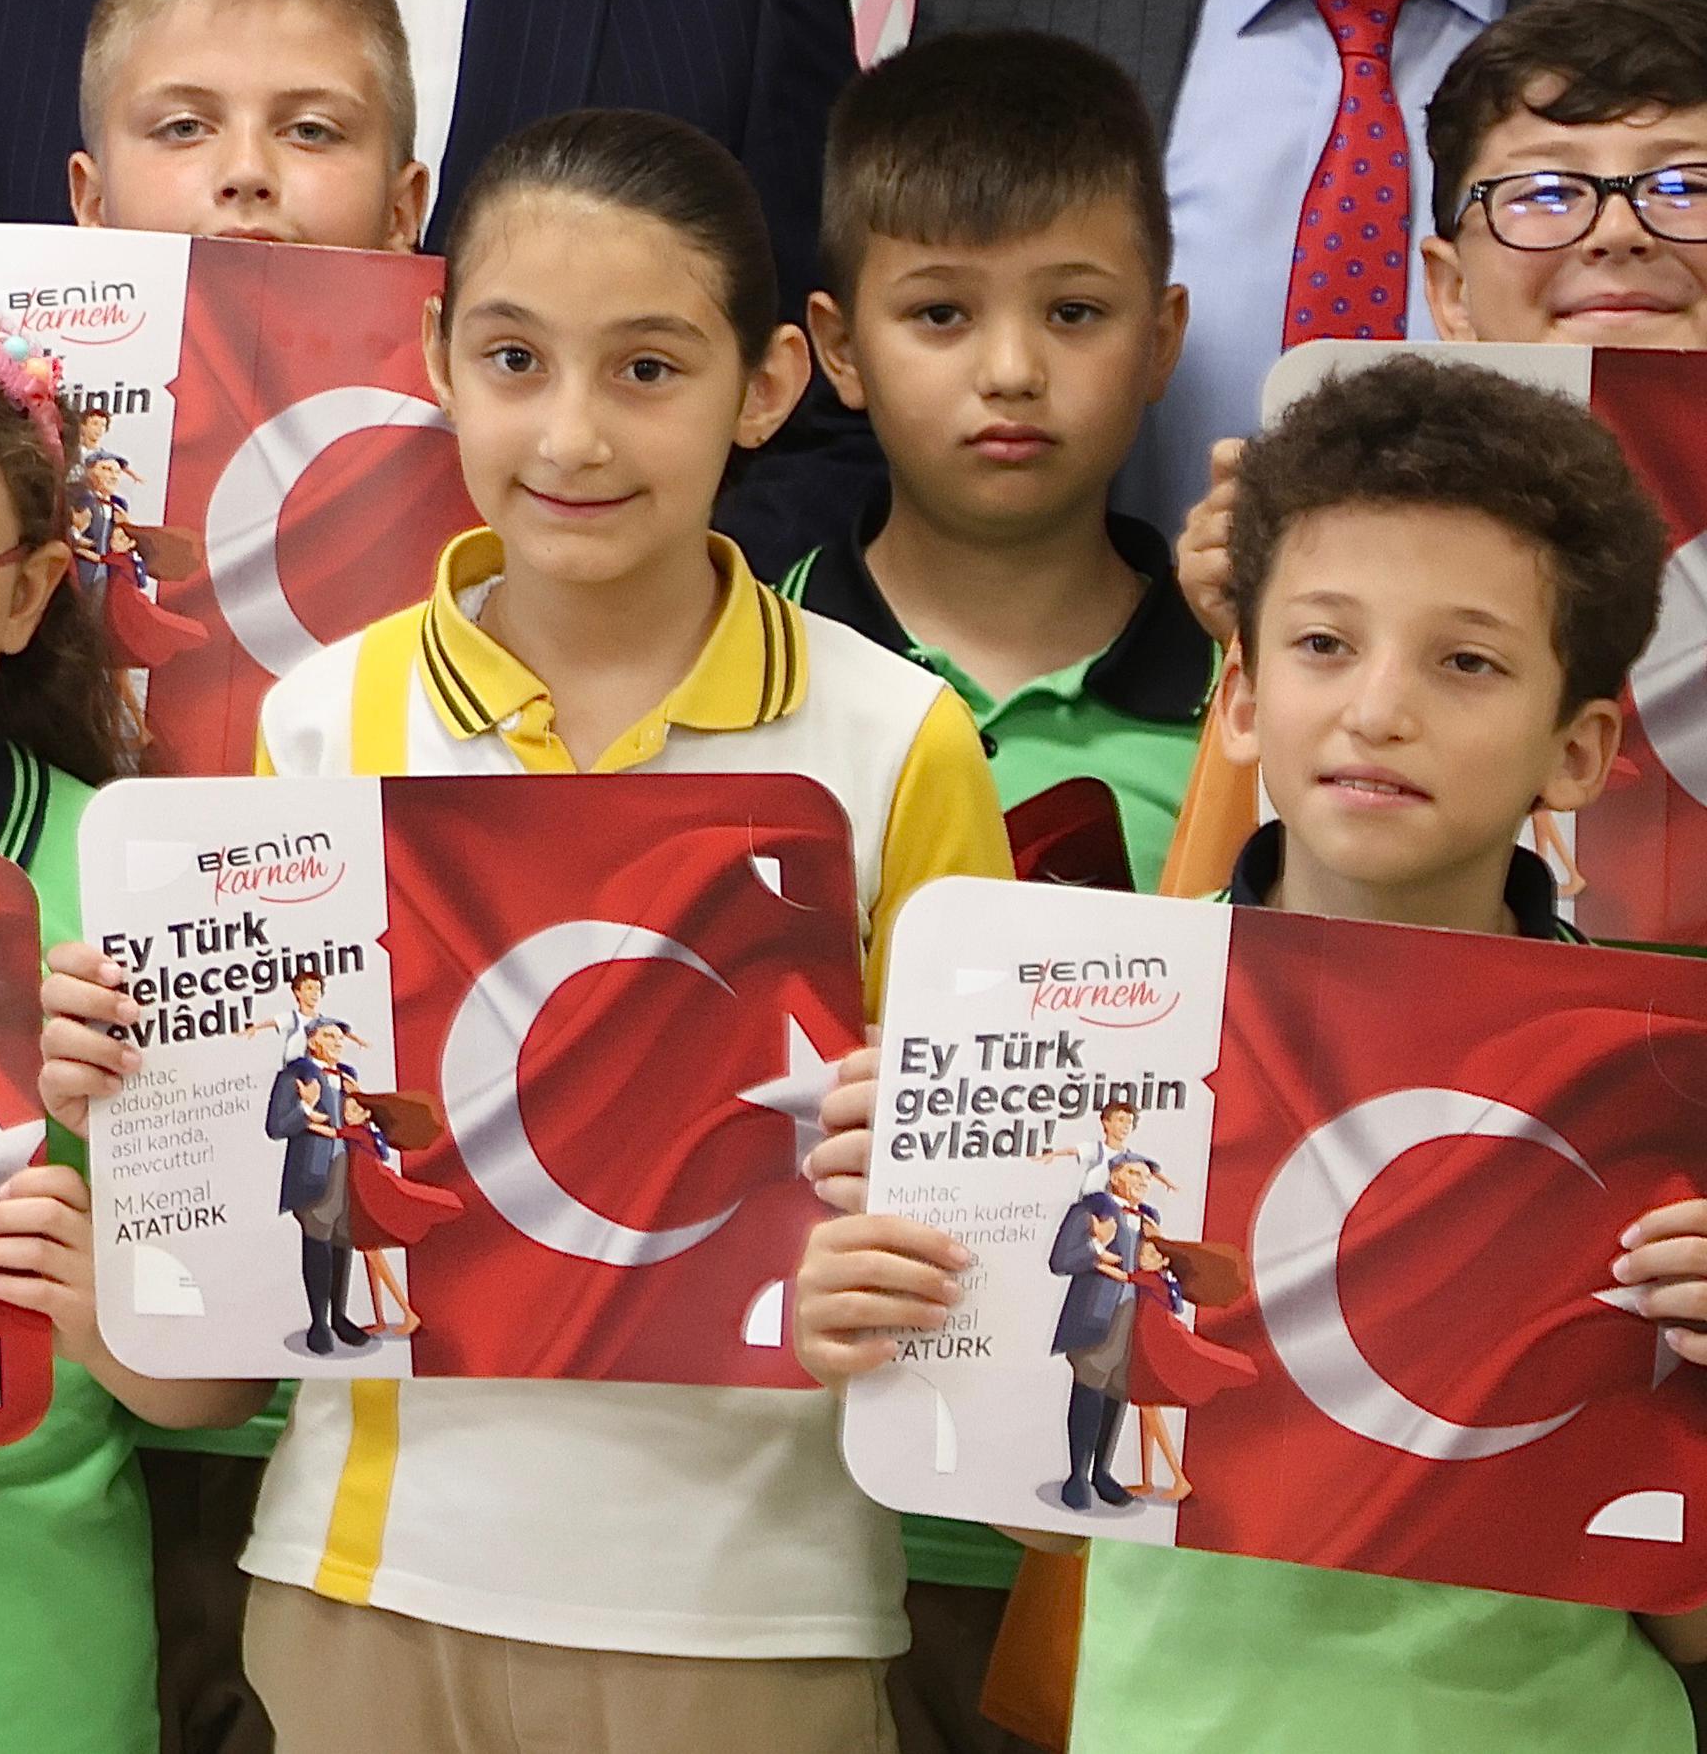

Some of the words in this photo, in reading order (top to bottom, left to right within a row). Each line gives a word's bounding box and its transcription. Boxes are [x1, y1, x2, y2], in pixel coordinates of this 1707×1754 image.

[214, 846, 328, 906] karnem
[103, 933, 154, 973] Ey
[168, 911, 270, 959] Türk
[115, 940, 364, 1006] eleceğinin
[1031, 958, 1161, 1020] karnem
[900, 1036, 959, 1080] Ey
[975, 1030, 1085, 1071] Türk
[122, 1069, 178, 1092] uhtaç
[895, 1072, 1187, 1126] geleceğinin
[891, 1119, 1057, 1161] evlâdı!
[112, 1145, 214, 1180] mevcuttur!
[114, 1179, 211, 1219] M.Kemal
[887, 1185, 961, 1205] Muhtaç
[116, 1203, 227, 1244] ATATÜRK
[892, 1335, 993, 1362] ATÜRK
